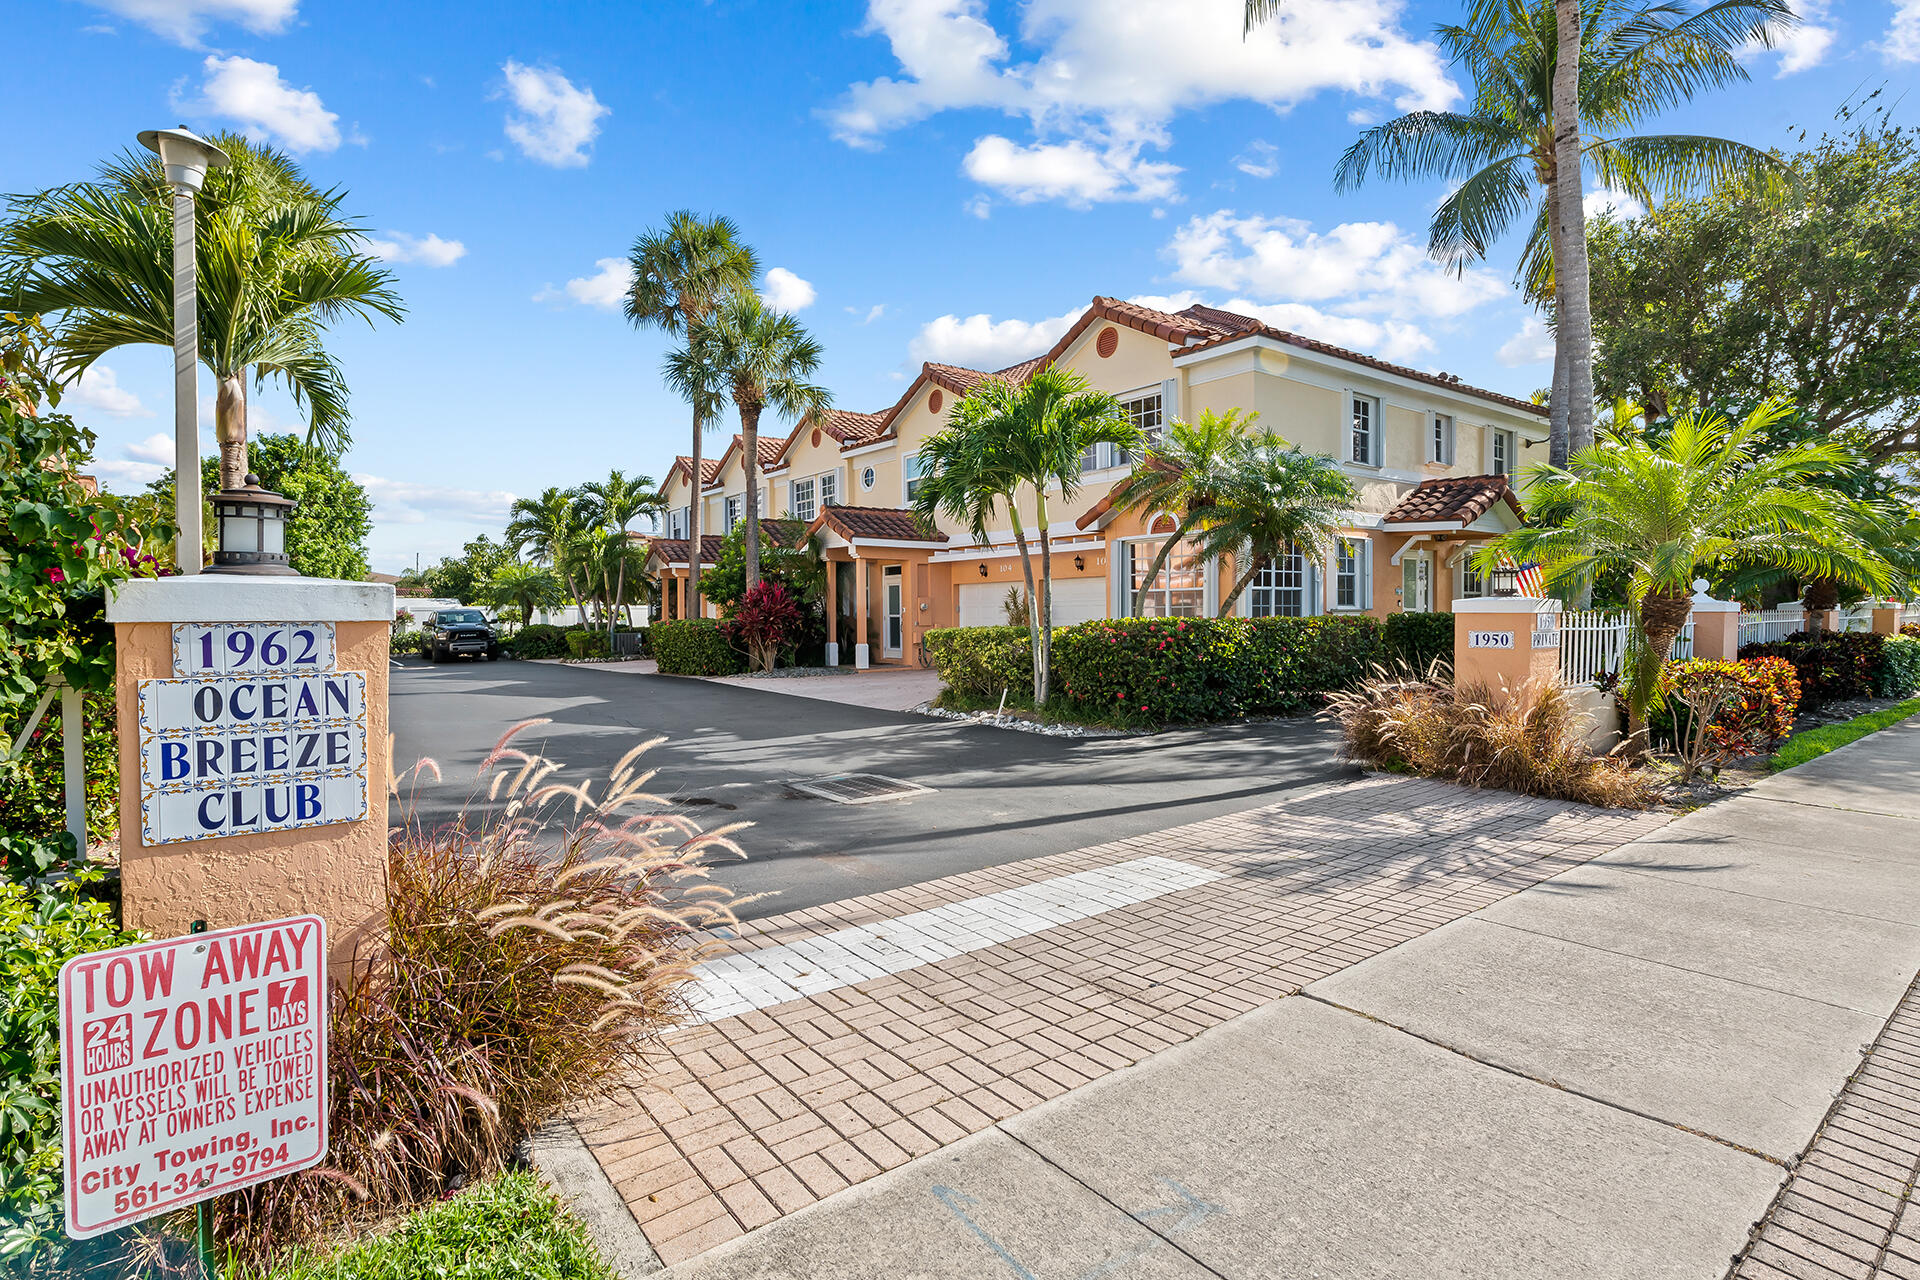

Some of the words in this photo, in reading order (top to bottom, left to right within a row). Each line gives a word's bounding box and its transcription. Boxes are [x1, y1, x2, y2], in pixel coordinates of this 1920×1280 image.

[1000, 564, 1012, 573] 104
[199, 629, 319, 669] 1962
[1475, 633, 1509, 646] 1950
[1532, 632, 1558, 647] PRIVATE
[193, 679, 350, 723] OCEAN
[160, 730, 351, 781] BREEZE
[197, 784, 322, 830] CLUB
[77, 948, 176, 1014] TOW
[200, 924, 312, 990] AWAY
[279, 980, 297, 1004] 7
[86, 1015, 130, 1049] 24
[143, 988, 260, 1060] ZONE
[270, 1000, 306, 1031] DAYS
[80, 1050, 224, 1109] UNAUTHORIZED
[233, 1029, 313, 1068] VEHICLES
[86, 1039, 131, 1075] HOURS
[81, 1106, 104, 1135] OR
[113, 1084, 186, 1126] VESSELS
[195, 1074, 231, 1104] WILL
[239, 1066, 257, 1093] BE
[265, 1053, 313, 1085] TOWED
[82, 1125, 130, 1163] AWAY
[138, 1118, 157, 1146] AT
[167, 1096, 236, 1137] OWNERS
[245, 1076, 313, 1116] EXPENSE
[81, 1162, 141, 1195] City
[154, 1131, 258, 1172] Towing,
[271, 1115, 316, 1138] Inc.
[114, 1142, 289, 1214] 561-347-9794
